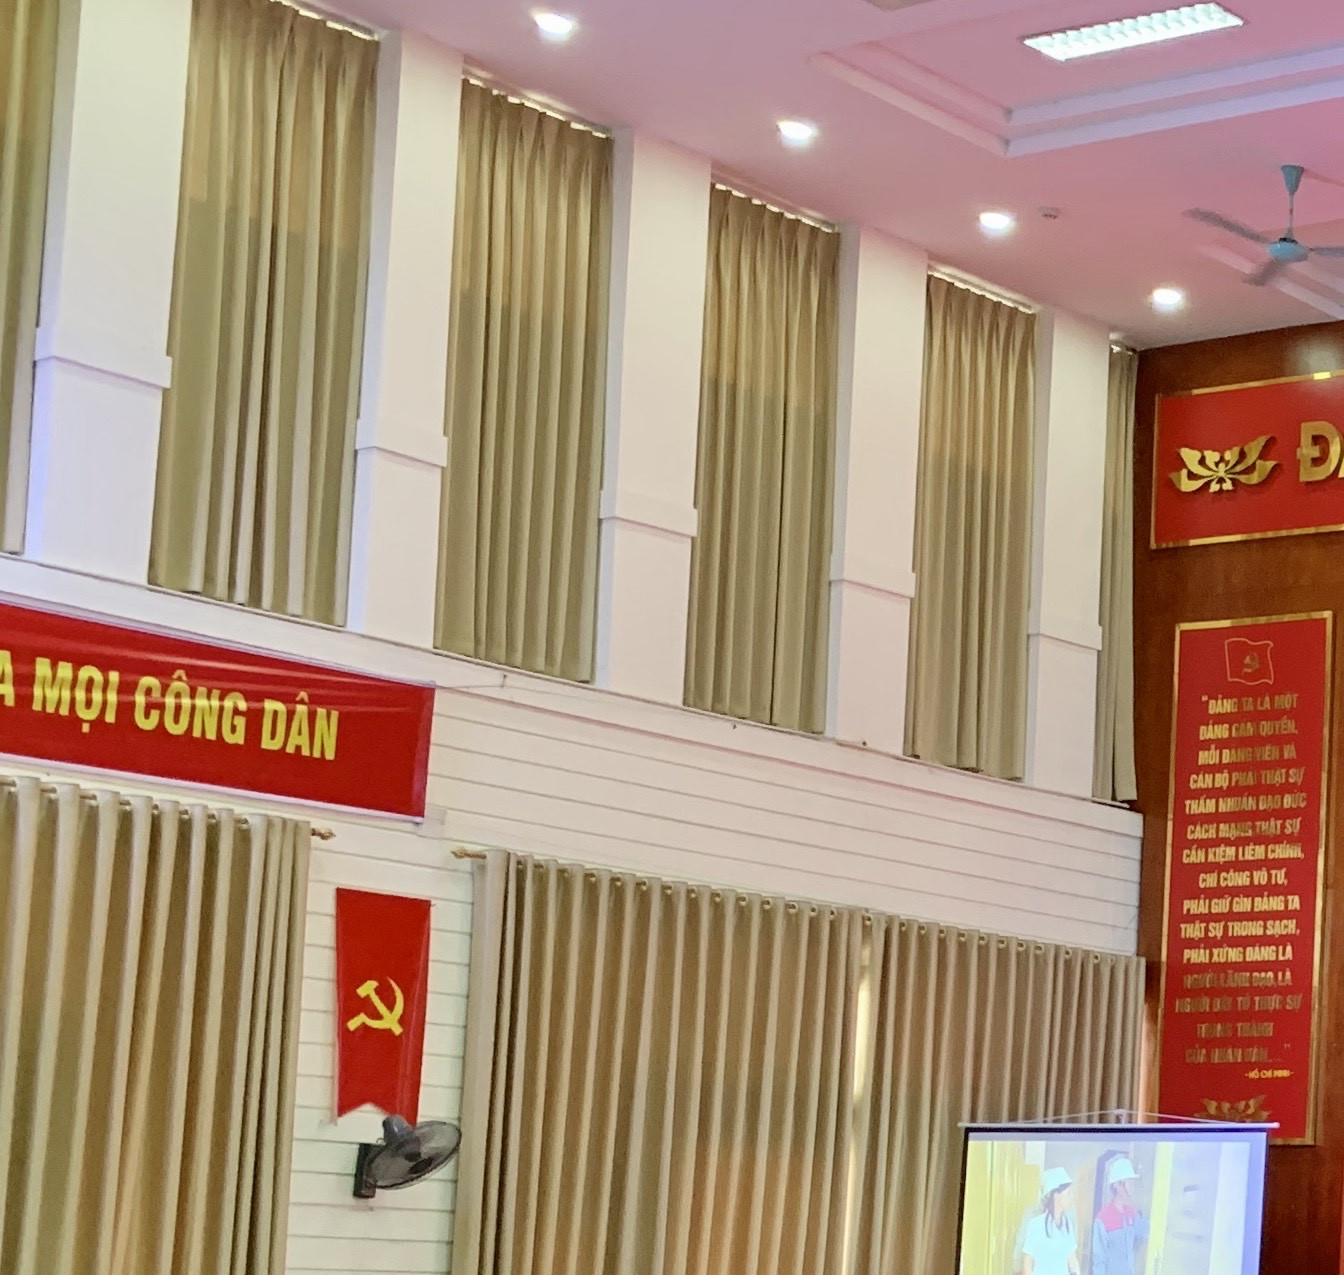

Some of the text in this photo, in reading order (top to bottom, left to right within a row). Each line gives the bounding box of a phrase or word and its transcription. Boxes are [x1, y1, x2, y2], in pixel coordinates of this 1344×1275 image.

[32, 656, 120, 733] MỌI
[134, 669, 248, 745] CÔNG
[261, 691, 339, 761] DÂN
[1199, 869, 1217, 888] CHÍ
[1220, 868, 1250, 887] CÔNG
[1253, 867, 1268, 885] VÔ
[1183, 894, 1209, 914] PHẢI
[1211, 894, 1231, 913] GIỮ
[1232, 894, 1252, 912] GÌN
[1288, 894, 1300, 910] TA
[1180, 919, 1206, 940] THẬT
[1208, 920, 1225, 940] SỰ
[1228, 920, 1264, 937] TRONG
[1183, 943, 1209, 964] PHẢI
[1212, 943, 1243, 963] XỨNG
[1278, 942, 1292, 961] LÀ
